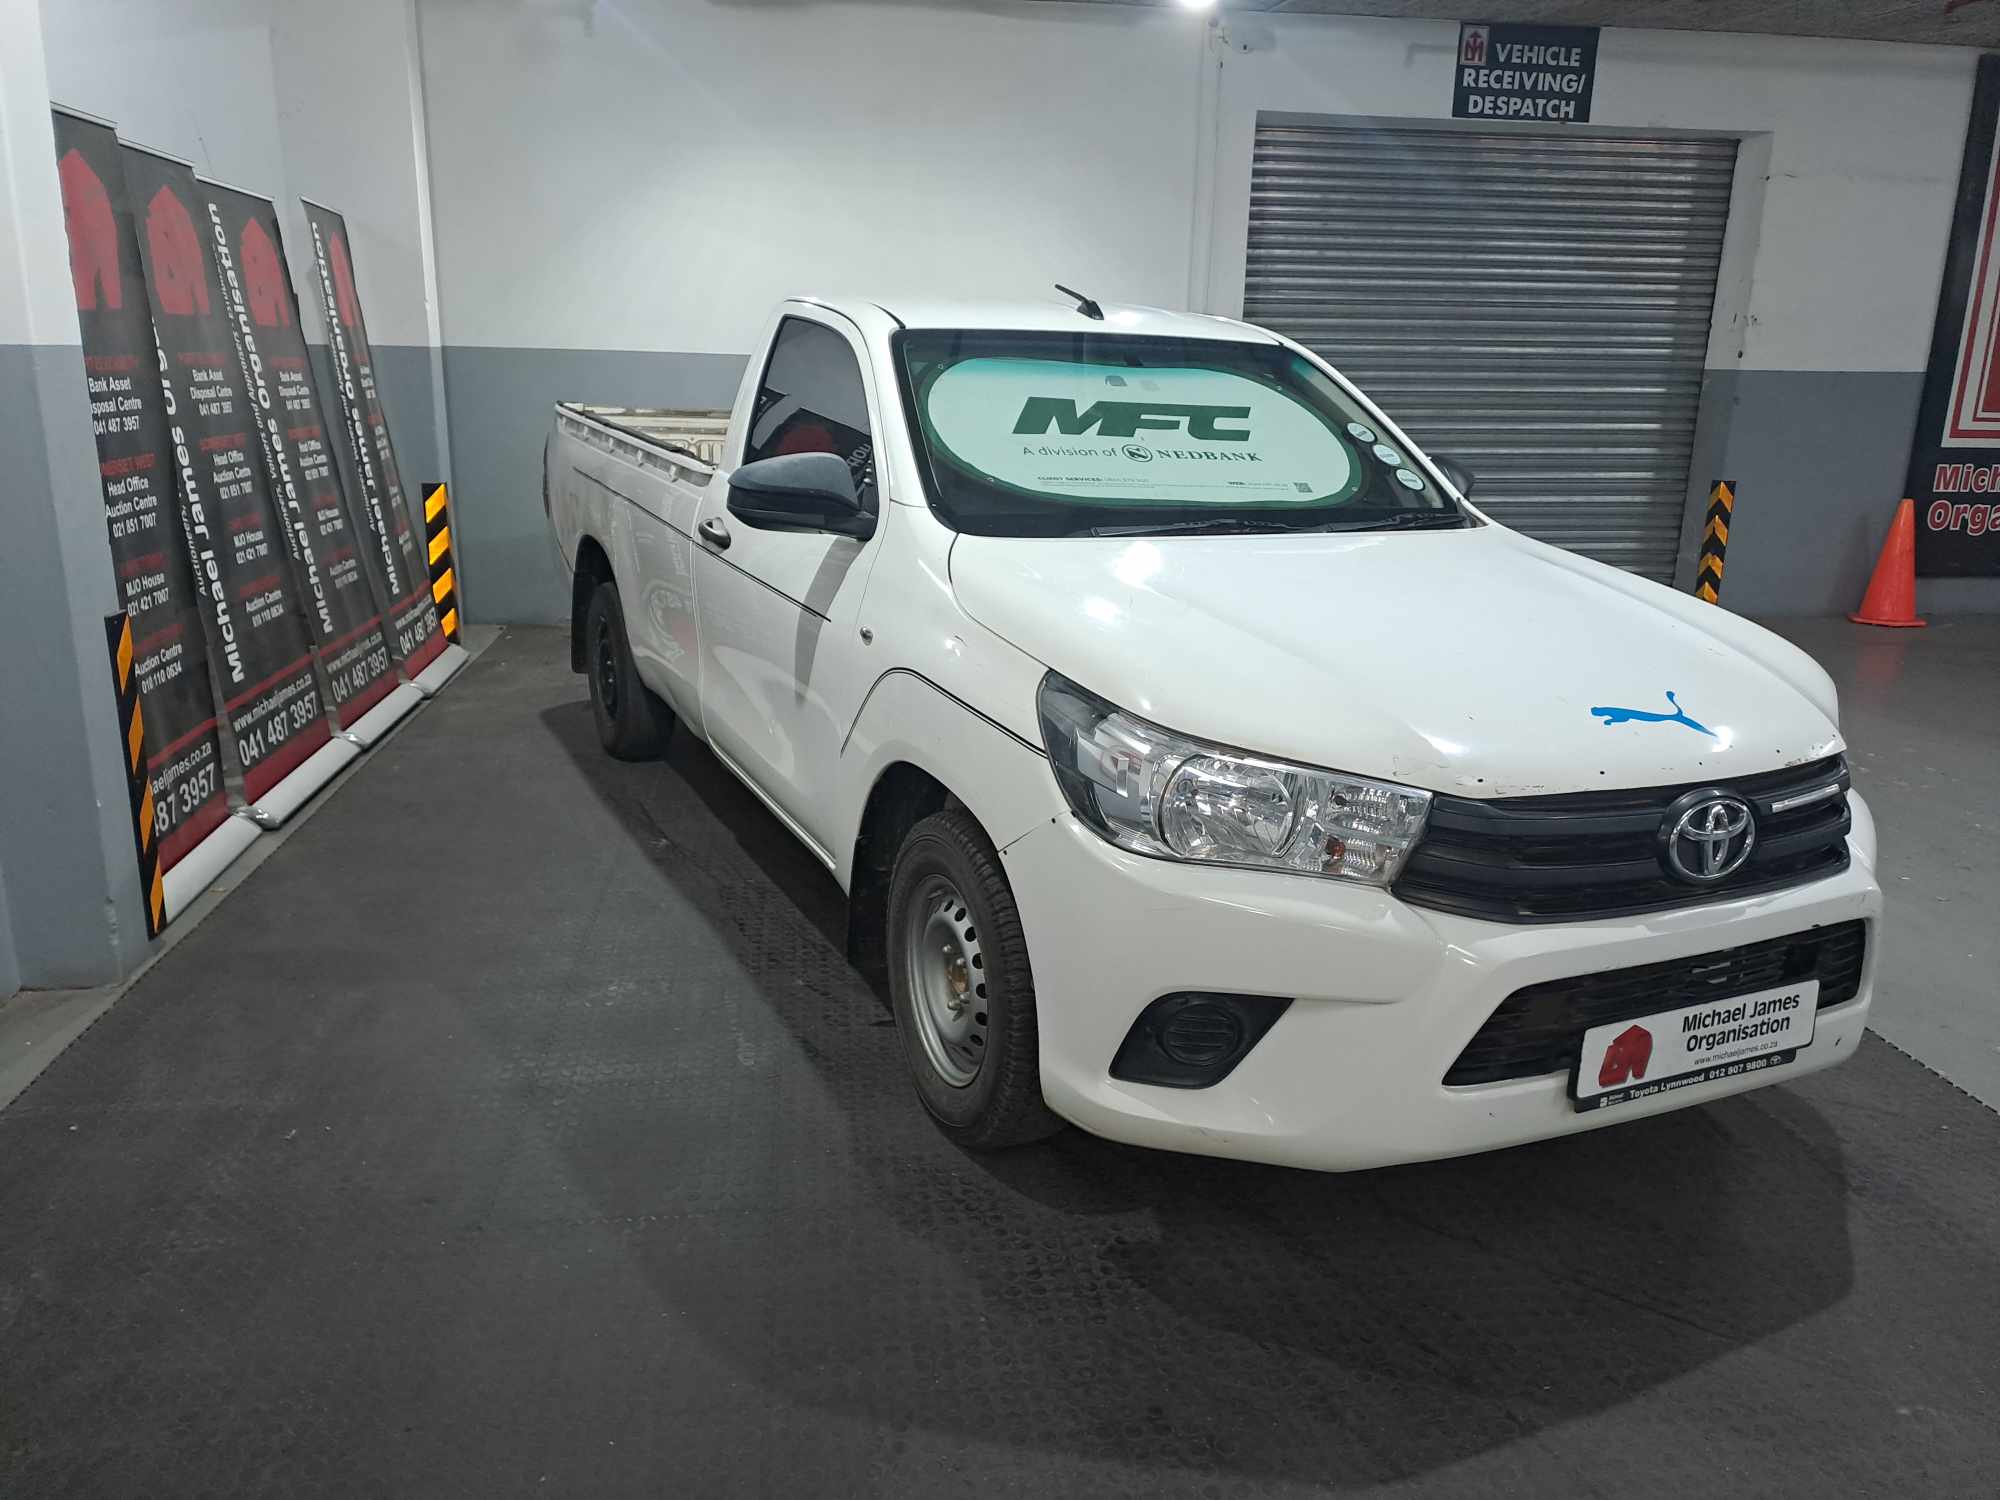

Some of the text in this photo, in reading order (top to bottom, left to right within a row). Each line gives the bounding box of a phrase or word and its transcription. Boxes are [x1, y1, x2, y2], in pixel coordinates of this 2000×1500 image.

[1495, 43, 1582, 67] VEHICLE
[1462, 68, 1586, 94] RECEIVING/
[1468, 94, 1576, 119] DESPATCH
[208, 203, 270, 409] Organisation
[311, 222, 354, 400] Organisation
[88, 376, 131, 392] Bank Asset
[117, 396, 142, 411] Centre
[1011, 396, 1251, 441] MFC
[93, 415, 140, 435] 041 487 3957
[267, 418, 300, 513] James
[352, 407, 376, 491] James
[1023, 445, 1263, 462] A division of NEDBANK
[107, 475, 149, 496] Head Office
[105, 495, 157, 518] Auction Centre
[112, 511, 157, 538] 021 851 7007
[172, 426, 245, 684] Michael James
[370, 498, 400, 595] Michael
[126, 572, 165, 597] MJO House
[294, 522, 333, 633] Michael
[127, 599, 140, 617] 021
[140, 592, 153, 610] 421
[134, 642, 183, 678] Auction Centre
[332, 646, 388, 703] 041 487 3957
[239, 691, 318, 766] 041 487 3957
[179, 762, 215, 813] 3957
[1682, 994, 1800, 1033] Michael James
[1686, 1016, 1791, 1052] Organisation
[1629, 1085, 1660, 1099] Toyota
[1660, 1073, 1705, 1092] Lynnwood
[1709, 1067, 1726, 1080] 012
